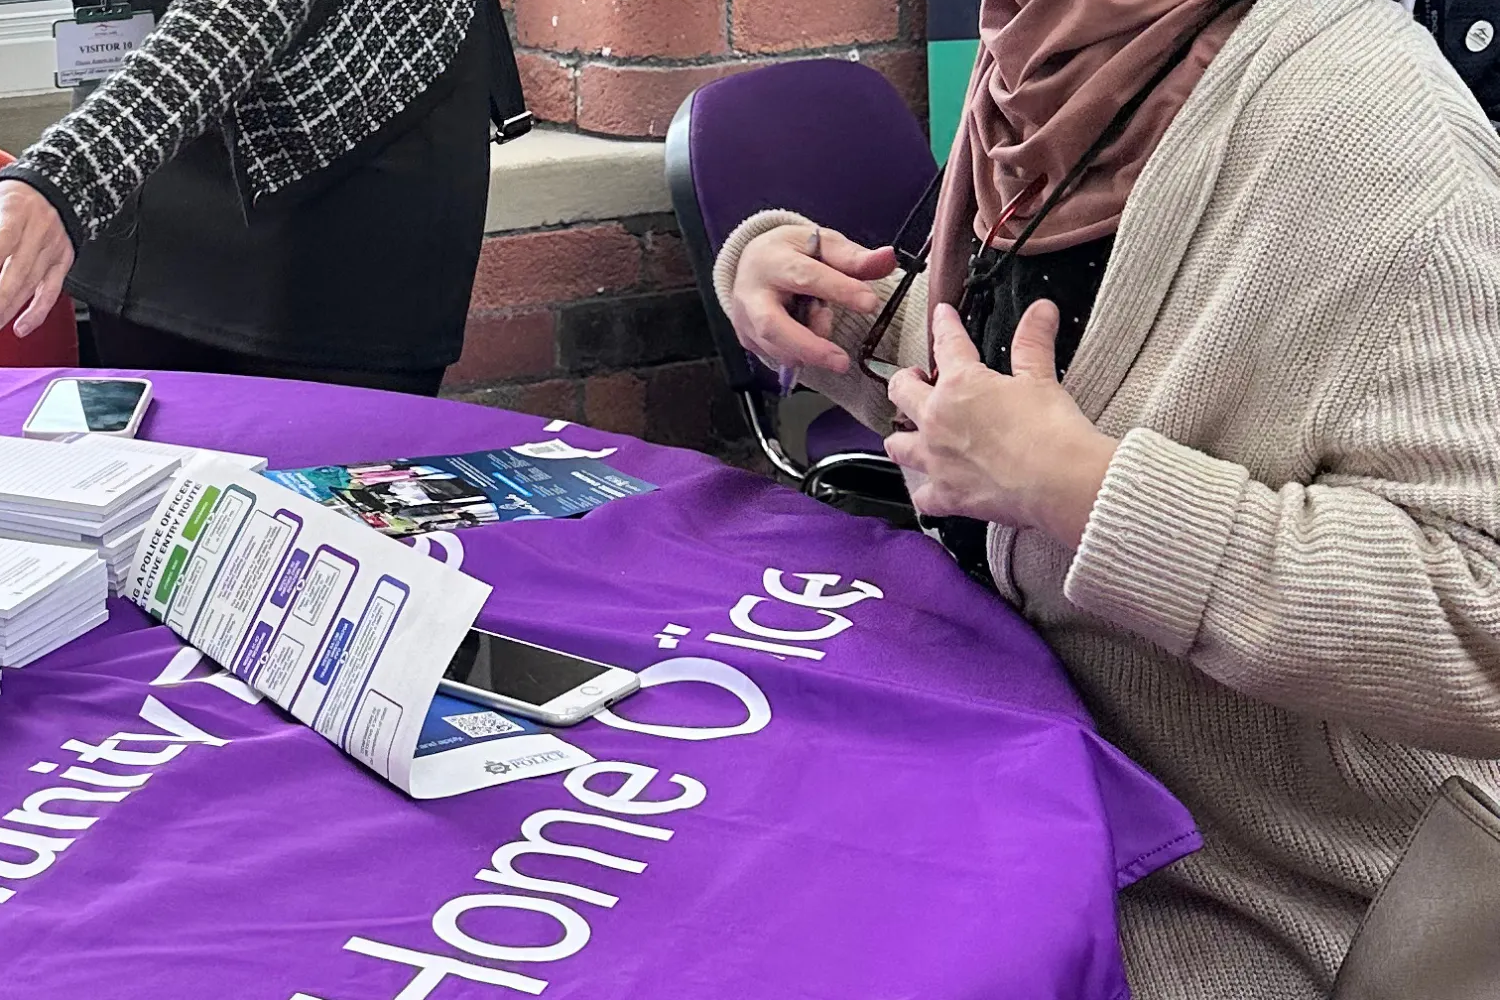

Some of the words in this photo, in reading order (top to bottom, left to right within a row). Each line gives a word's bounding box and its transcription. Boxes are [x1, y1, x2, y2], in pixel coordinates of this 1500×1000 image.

[79, 43, 120, 54] VISITOR
[123, 41, 133, 50] 10
[162, 478, 194, 528] OFFICER
[161, 518, 181, 555] ENTRY
[179, 483, 203, 518] ROUTE
[140, 527, 164, 573] POLICE
[137, 576, 145, 587] A
[510, 752, 569, 769] POLICE
